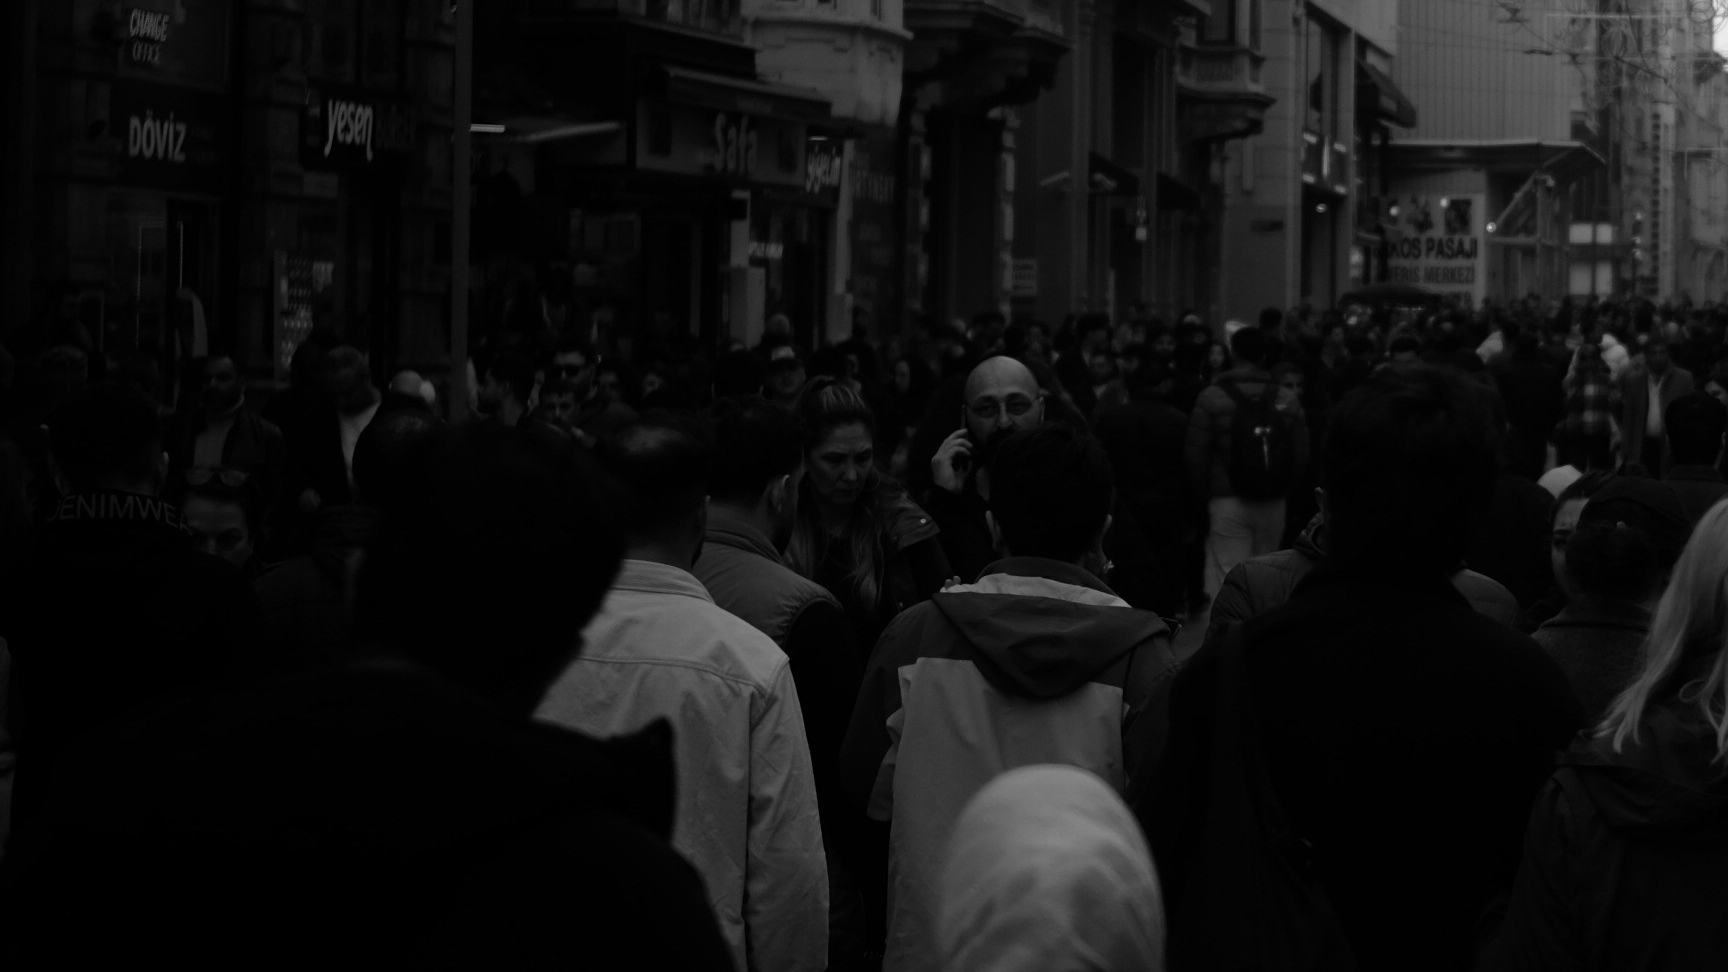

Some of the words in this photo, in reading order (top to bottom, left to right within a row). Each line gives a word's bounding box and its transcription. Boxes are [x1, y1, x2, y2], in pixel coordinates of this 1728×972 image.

[129, 8, 169, 42] CHANGE
[128, 109, 187, 163] DÖVİZ
[324, 99, 373, 163] yesen
